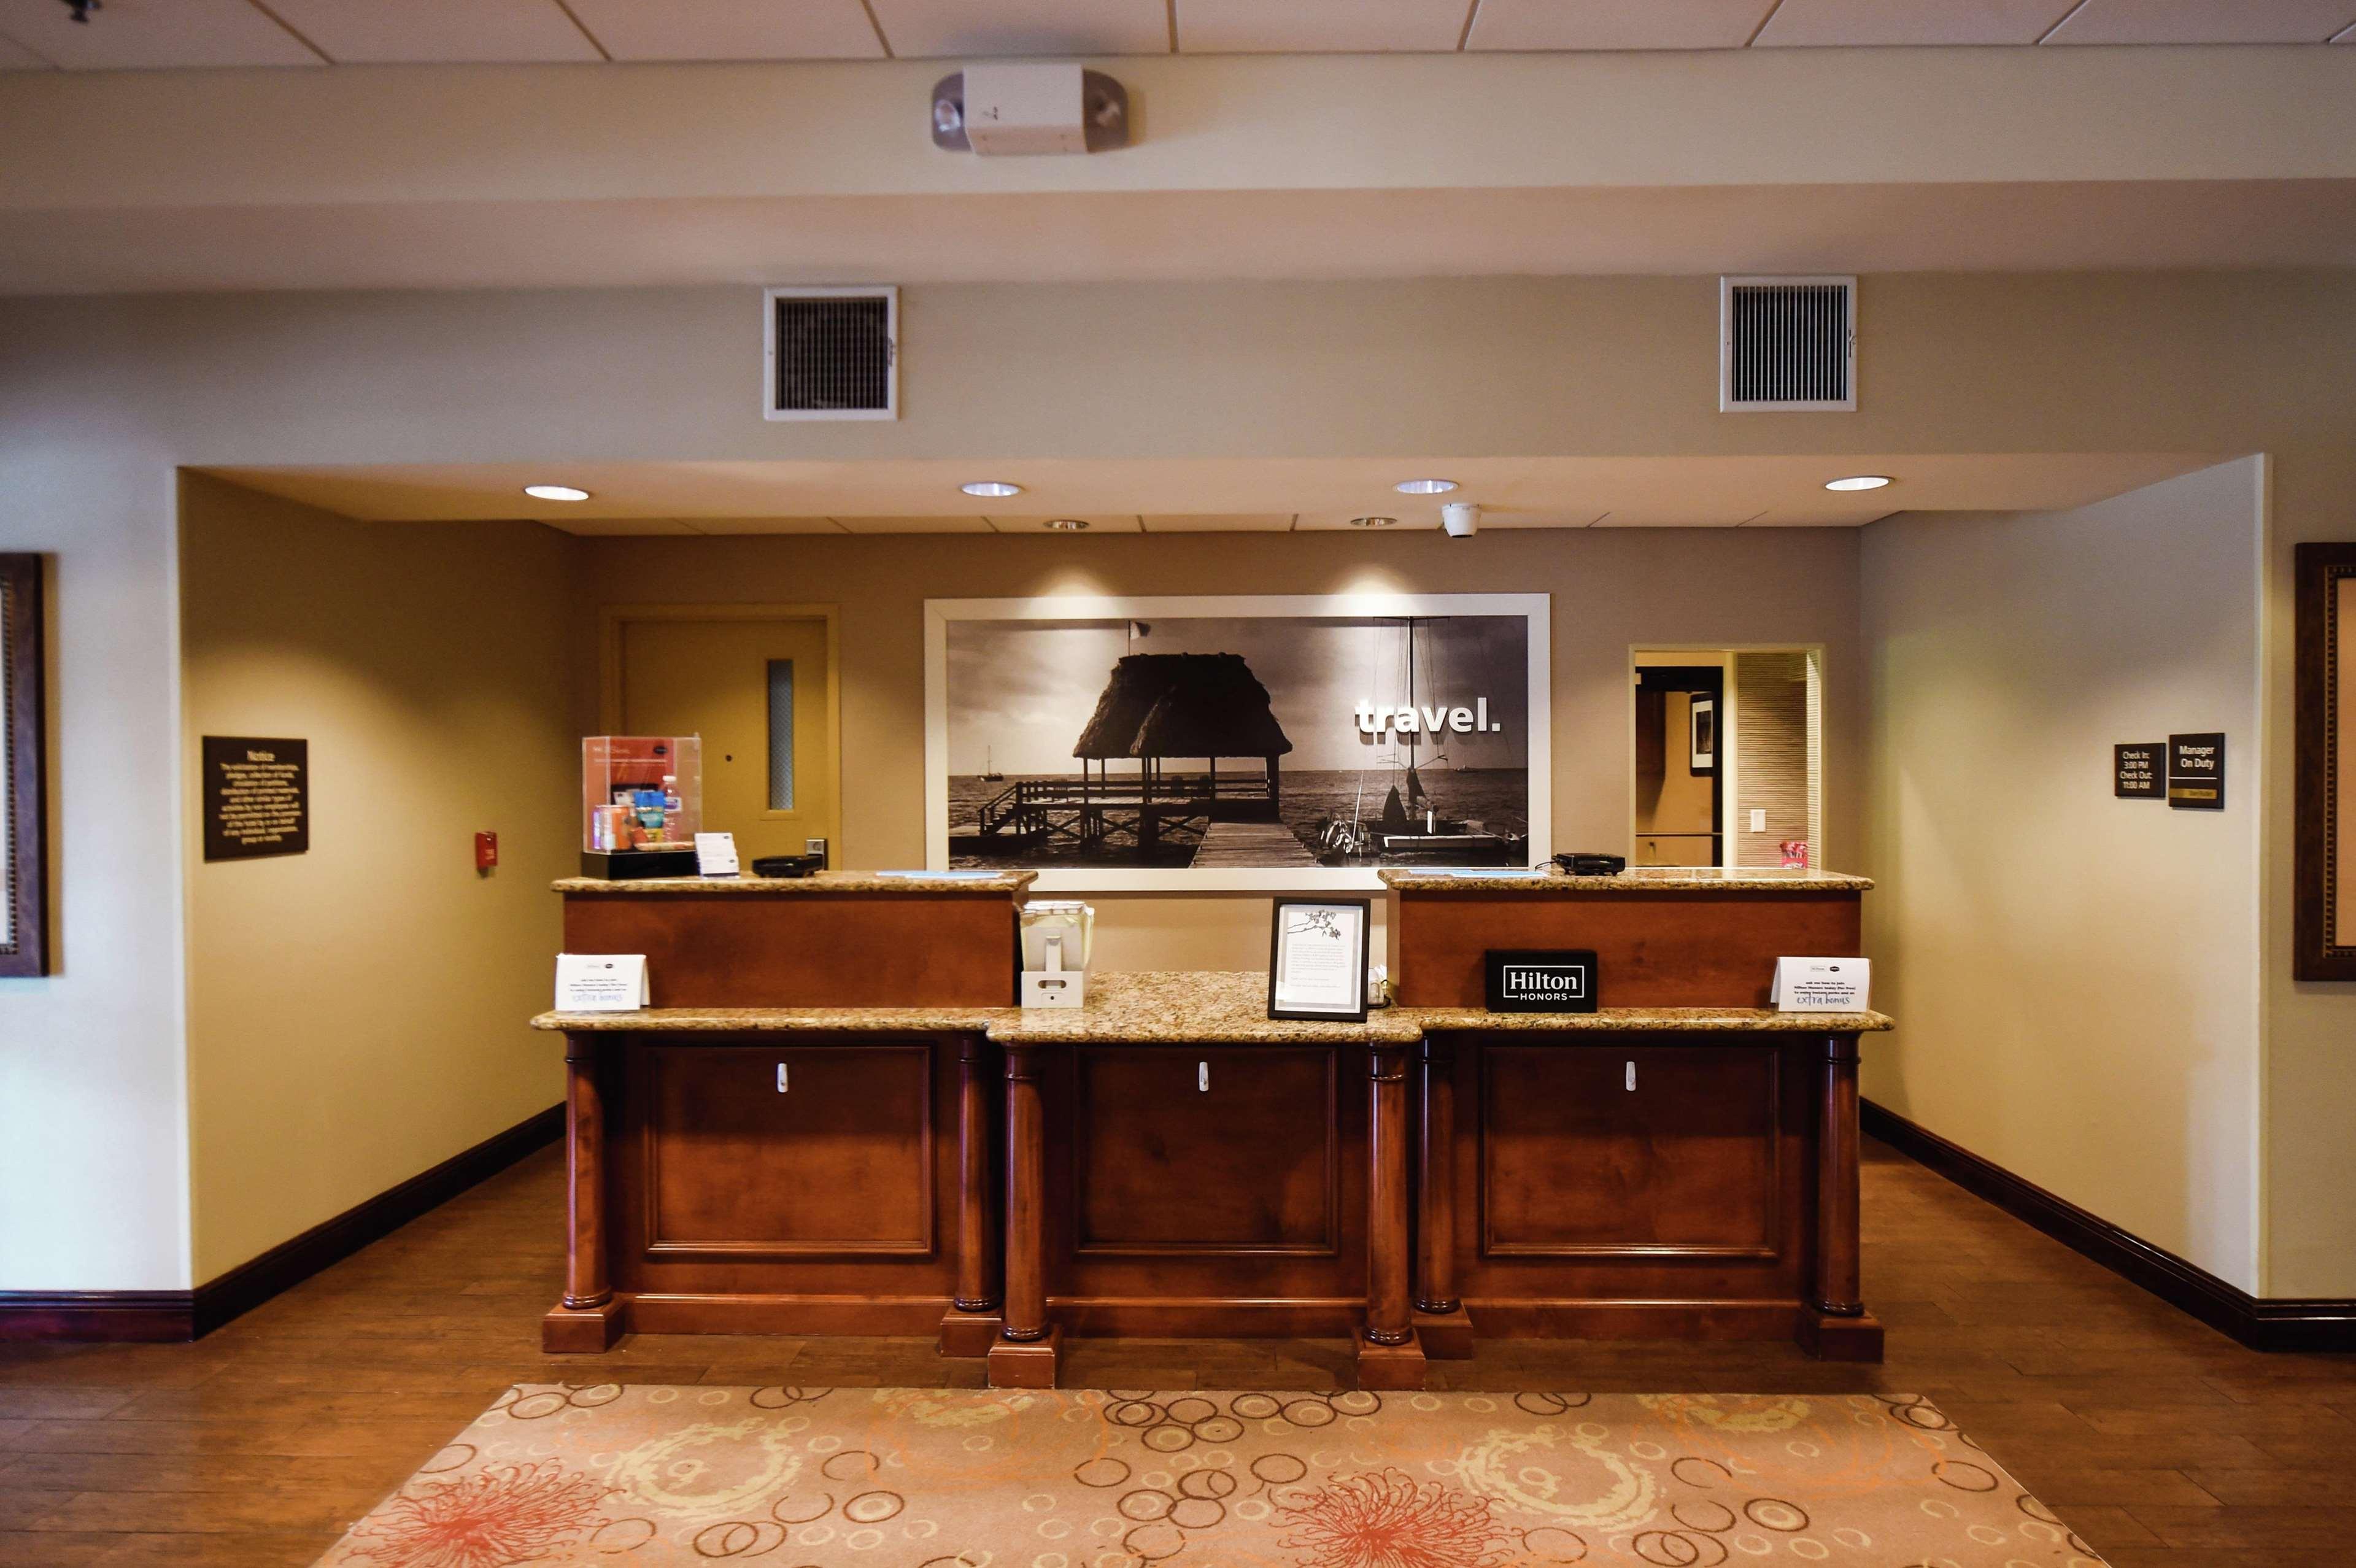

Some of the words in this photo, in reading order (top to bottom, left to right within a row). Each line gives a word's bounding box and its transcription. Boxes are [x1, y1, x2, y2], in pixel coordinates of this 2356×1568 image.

[1354, 697, 1501, 733] travel.
[2122, 751, 2141, 759] Check
[2179, 745, 2215, 757] Manager
[2180, 758, 2193, 768] On
[2195, 758, 2215, 770] Duty
[2120, 771, 2138, 779] Check
[1510, 972, 1578, 989] Hilton
[1797, 994, 1823, 1006] extra
[1825, 993, 1850, 1005] bonus
